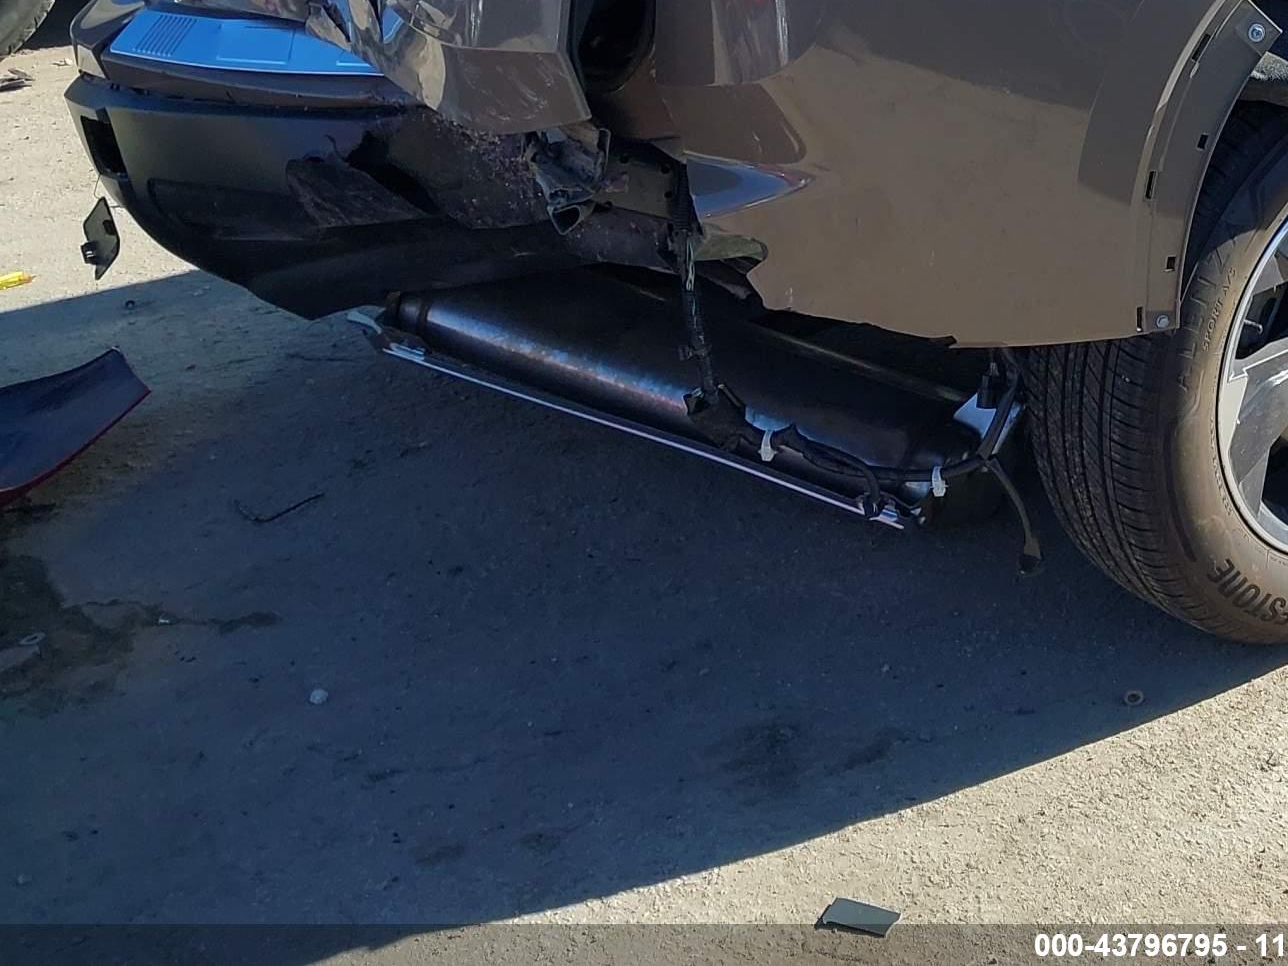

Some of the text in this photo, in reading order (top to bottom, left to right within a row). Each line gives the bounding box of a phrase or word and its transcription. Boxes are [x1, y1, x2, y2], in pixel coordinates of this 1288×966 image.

[1178, 237, 1236, 392] ALENZ
[1202, 267, 1236, 352] SPORT A/S
